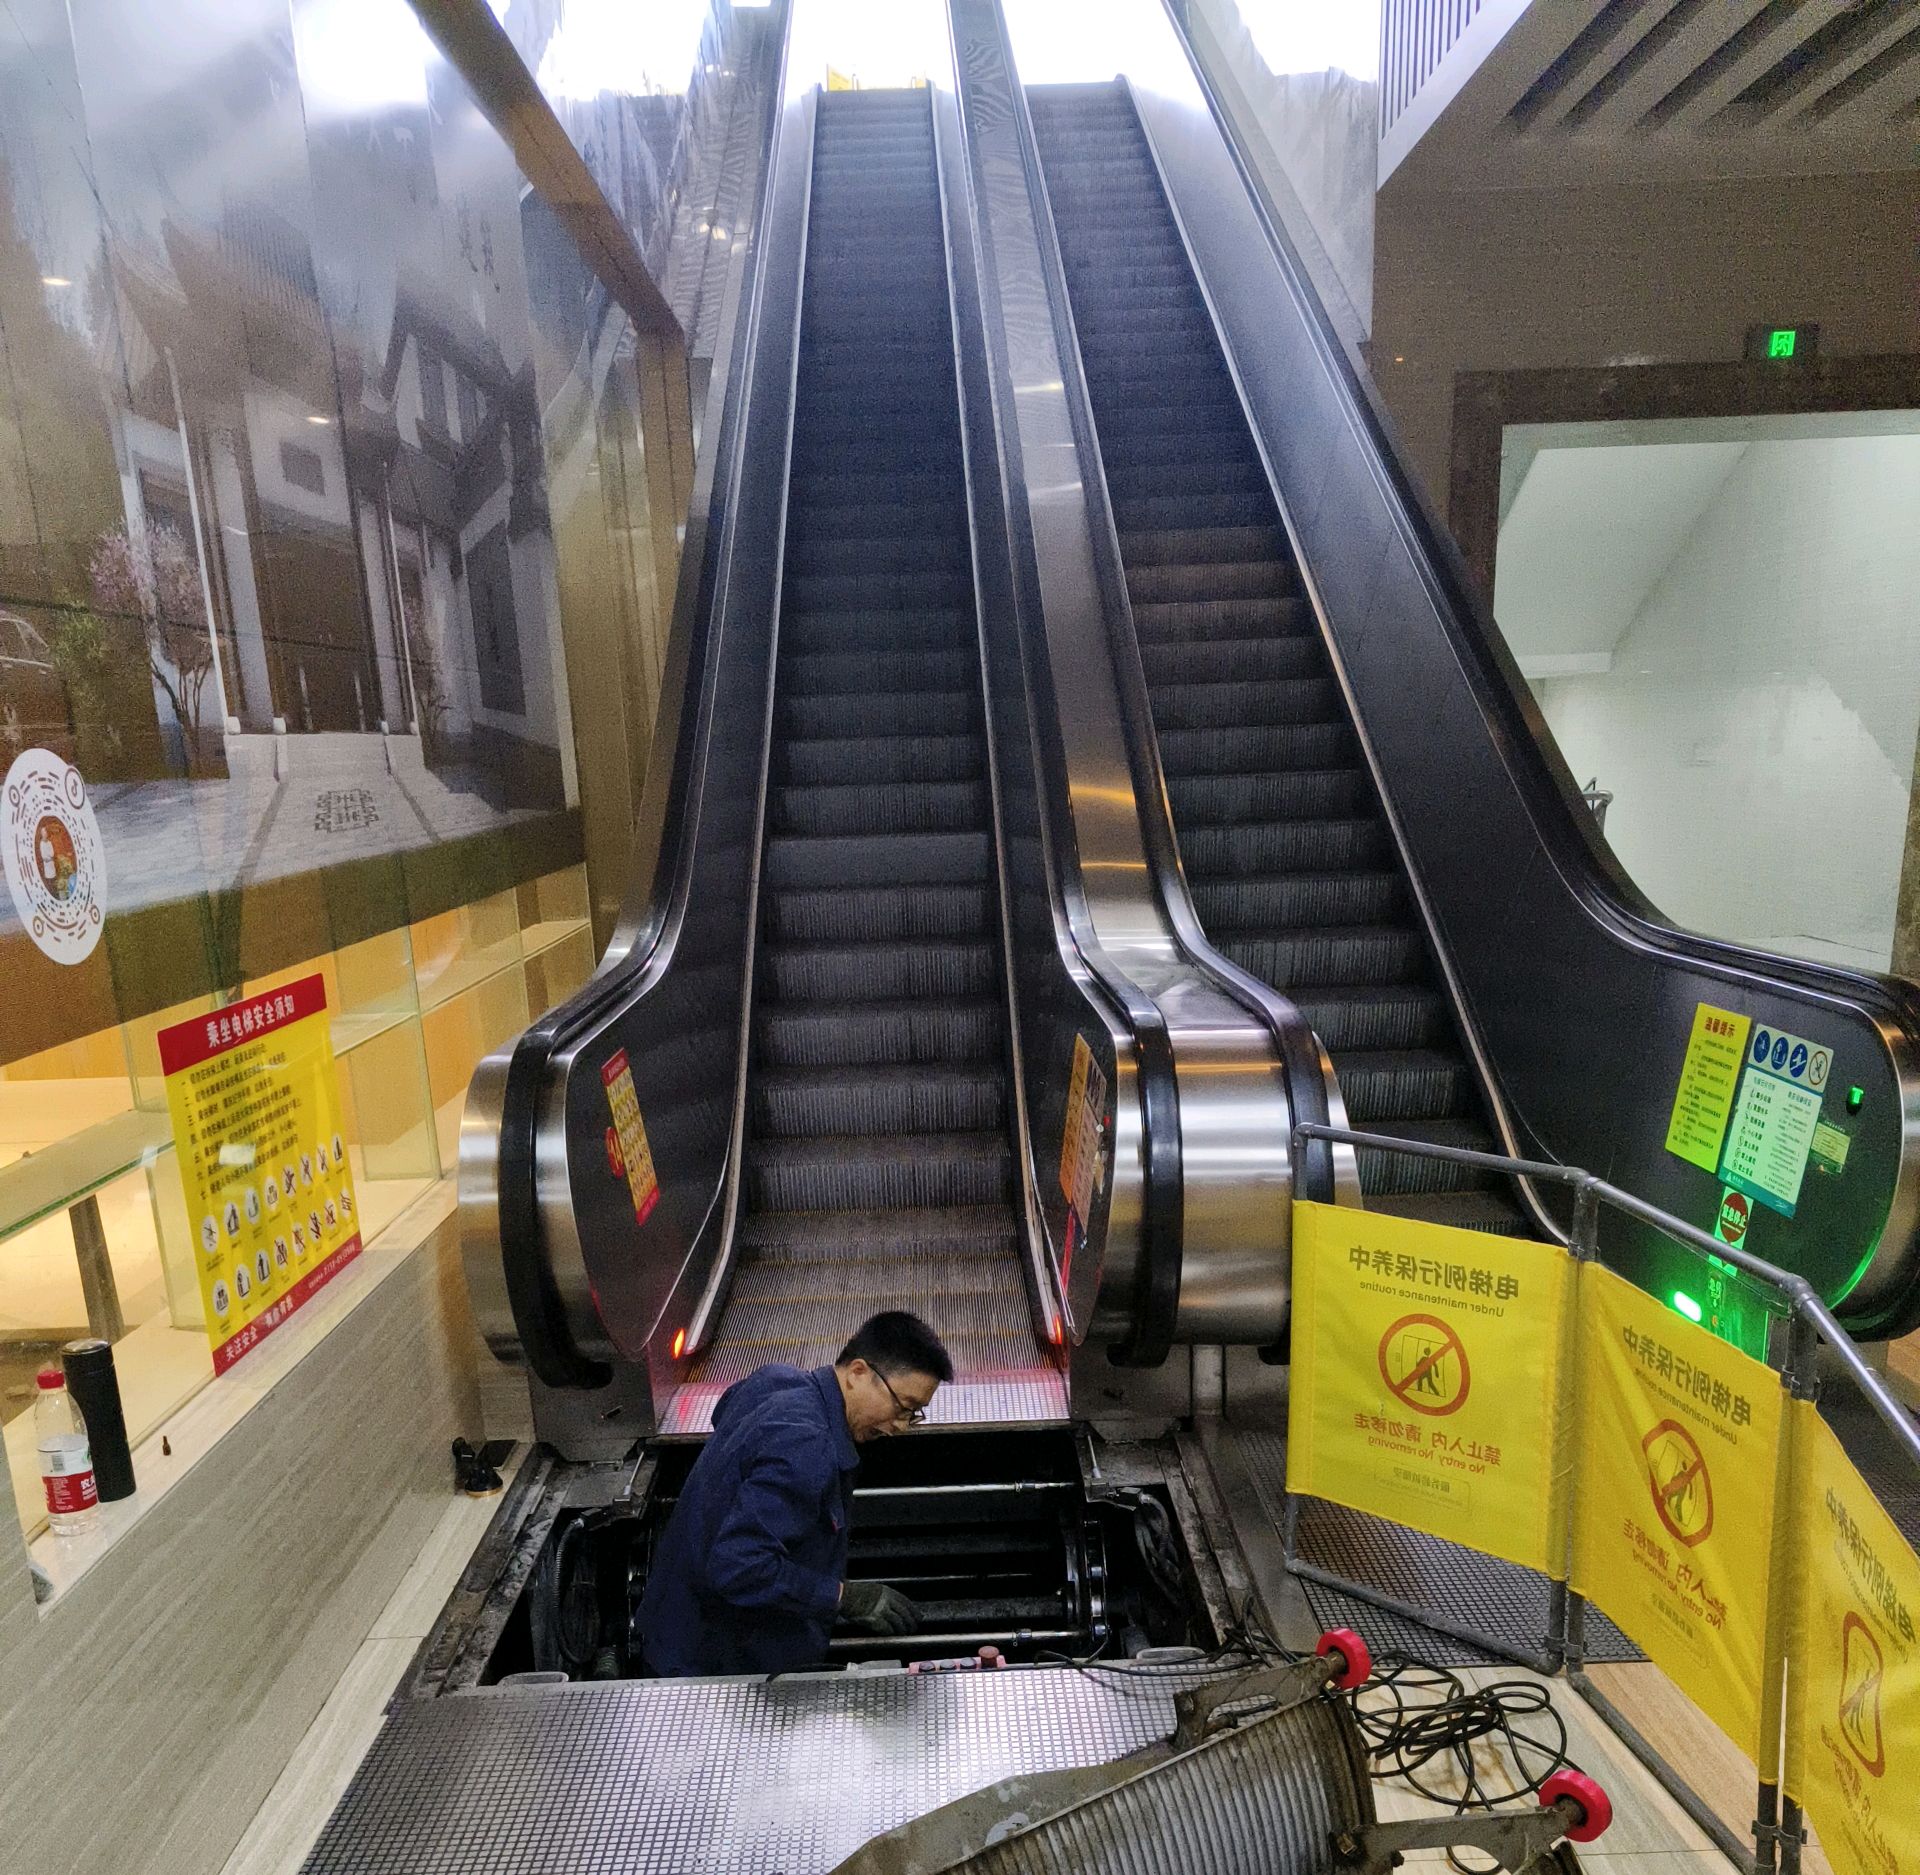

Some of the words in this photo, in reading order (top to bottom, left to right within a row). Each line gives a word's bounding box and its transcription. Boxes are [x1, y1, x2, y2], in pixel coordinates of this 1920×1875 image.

[206, 994, 295, 1049] 乘坐电梯安全须知
